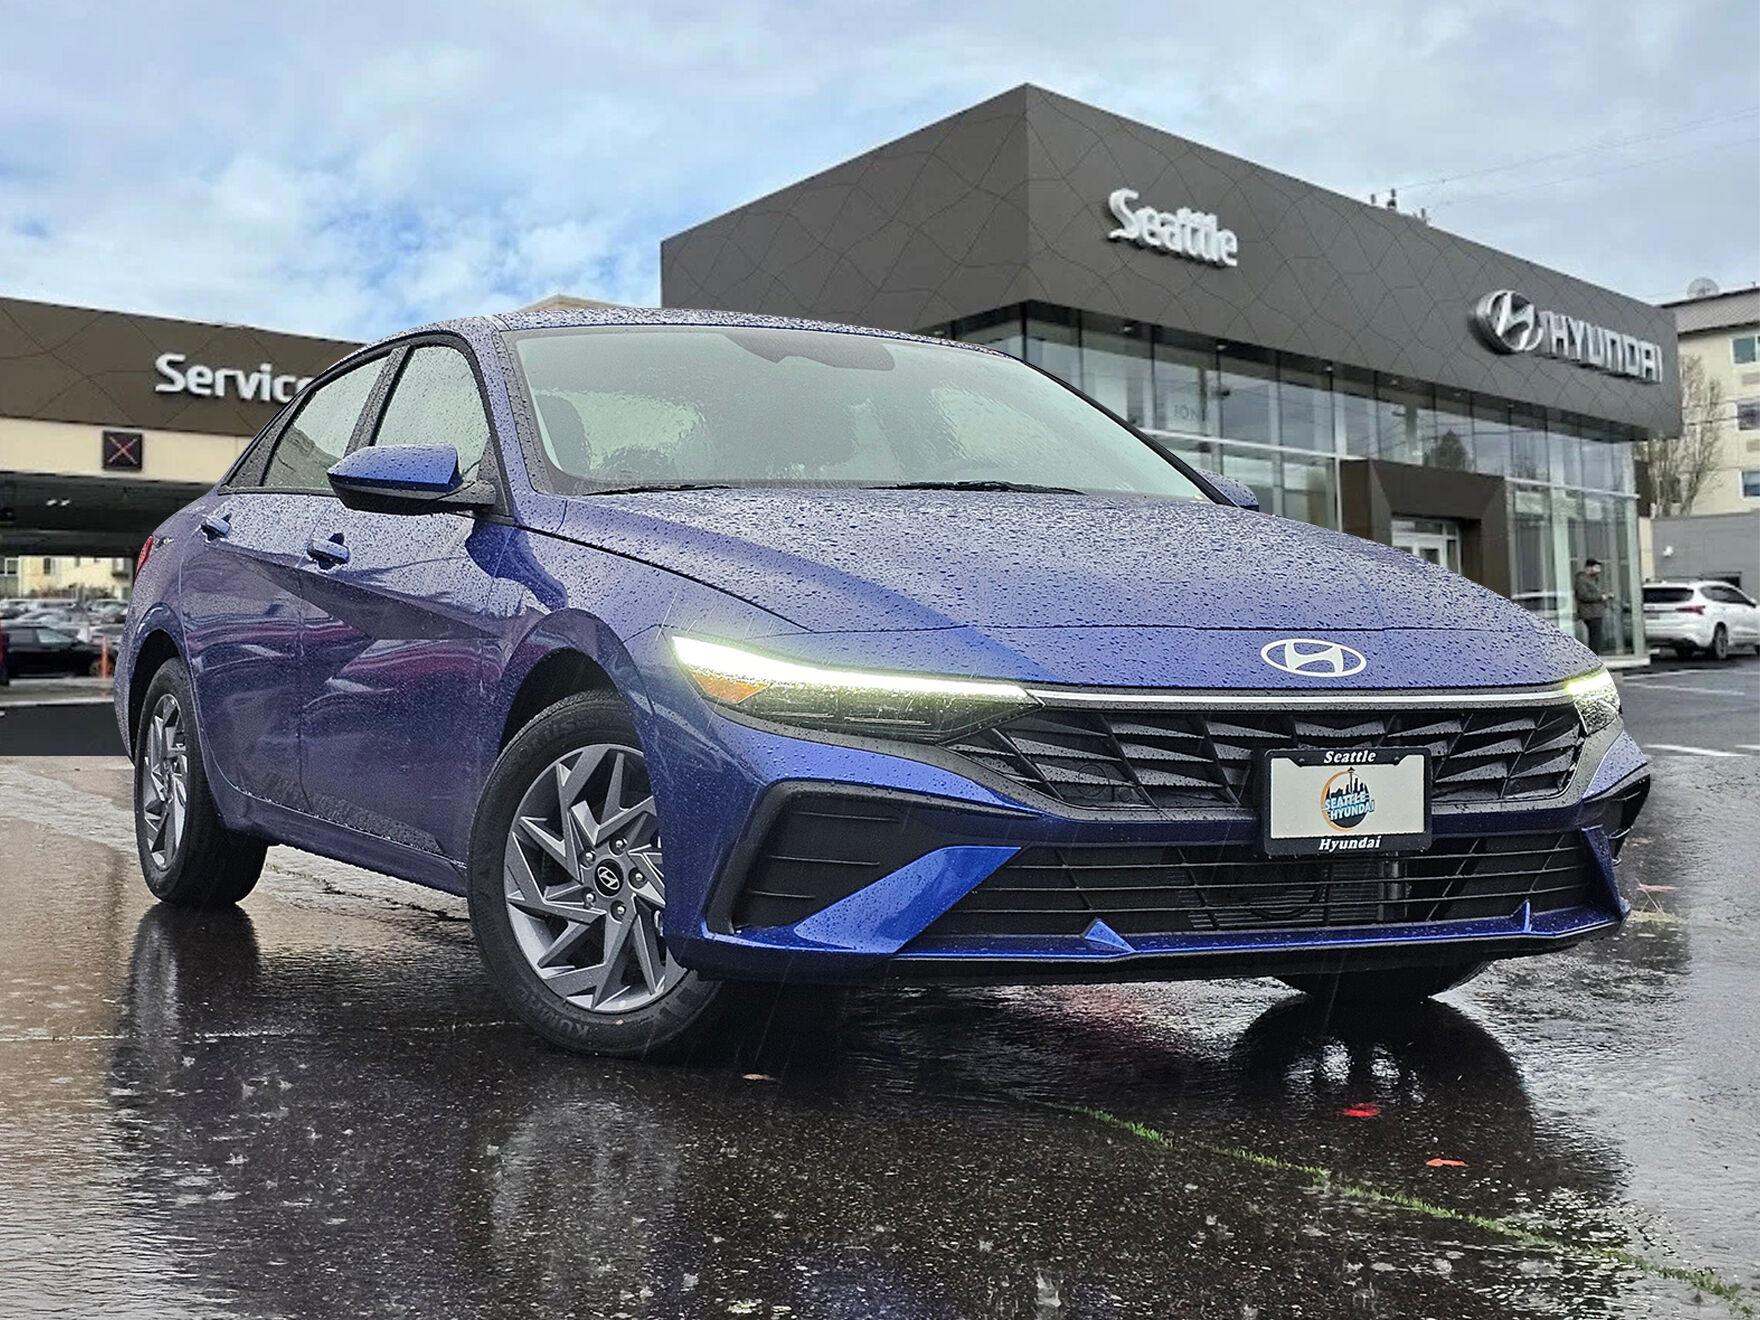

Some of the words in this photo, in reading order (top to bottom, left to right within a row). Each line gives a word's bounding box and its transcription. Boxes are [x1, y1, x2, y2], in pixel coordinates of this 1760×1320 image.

[1108, 188, 1238, 266] Seattle
[1545, 310, 1663, 383] HYUNDAI
[1323, 750, 1377, 764] Seattle
[1325, 790, 1368, 811] SEATTLE
[1329, 799, 1376, 821] HYUNDAI
[1318, 835, 1382, 853] Hyundai
